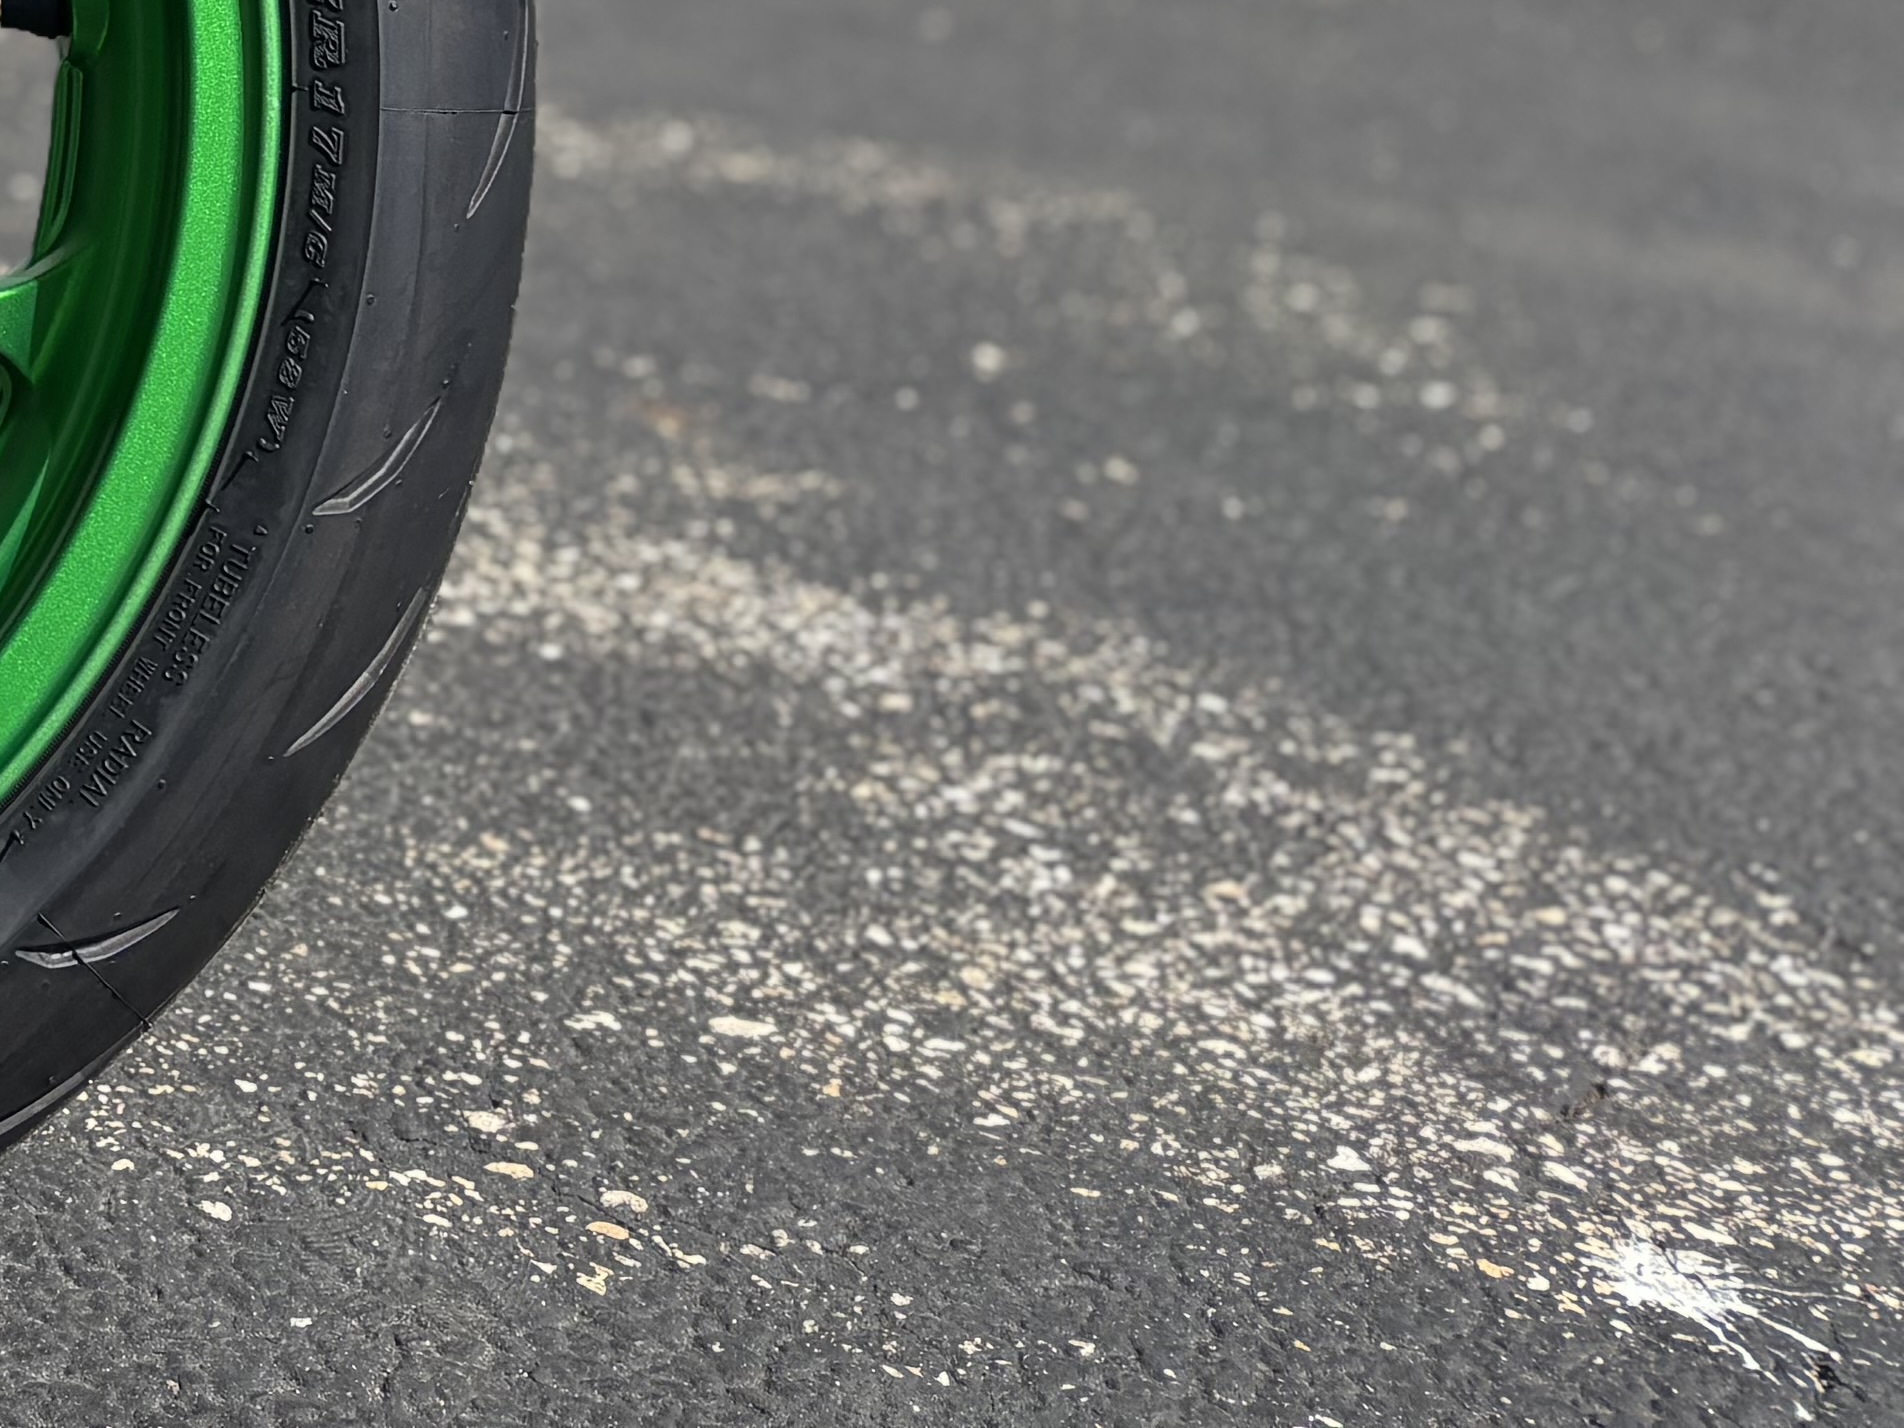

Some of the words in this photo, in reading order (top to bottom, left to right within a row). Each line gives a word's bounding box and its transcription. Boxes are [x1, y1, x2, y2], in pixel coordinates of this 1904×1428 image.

[193, 526, 228, 573] FOR
[154, 578, 202, 651] FRONT
[162, 544, 252, 686] TUBELESS
[104, 655, 159, 719] WHEEL
[68, 731, 108, 771] USE
[72, 719, 153, 808] RADIAL
[23, 776, 71, 830] ONLY
